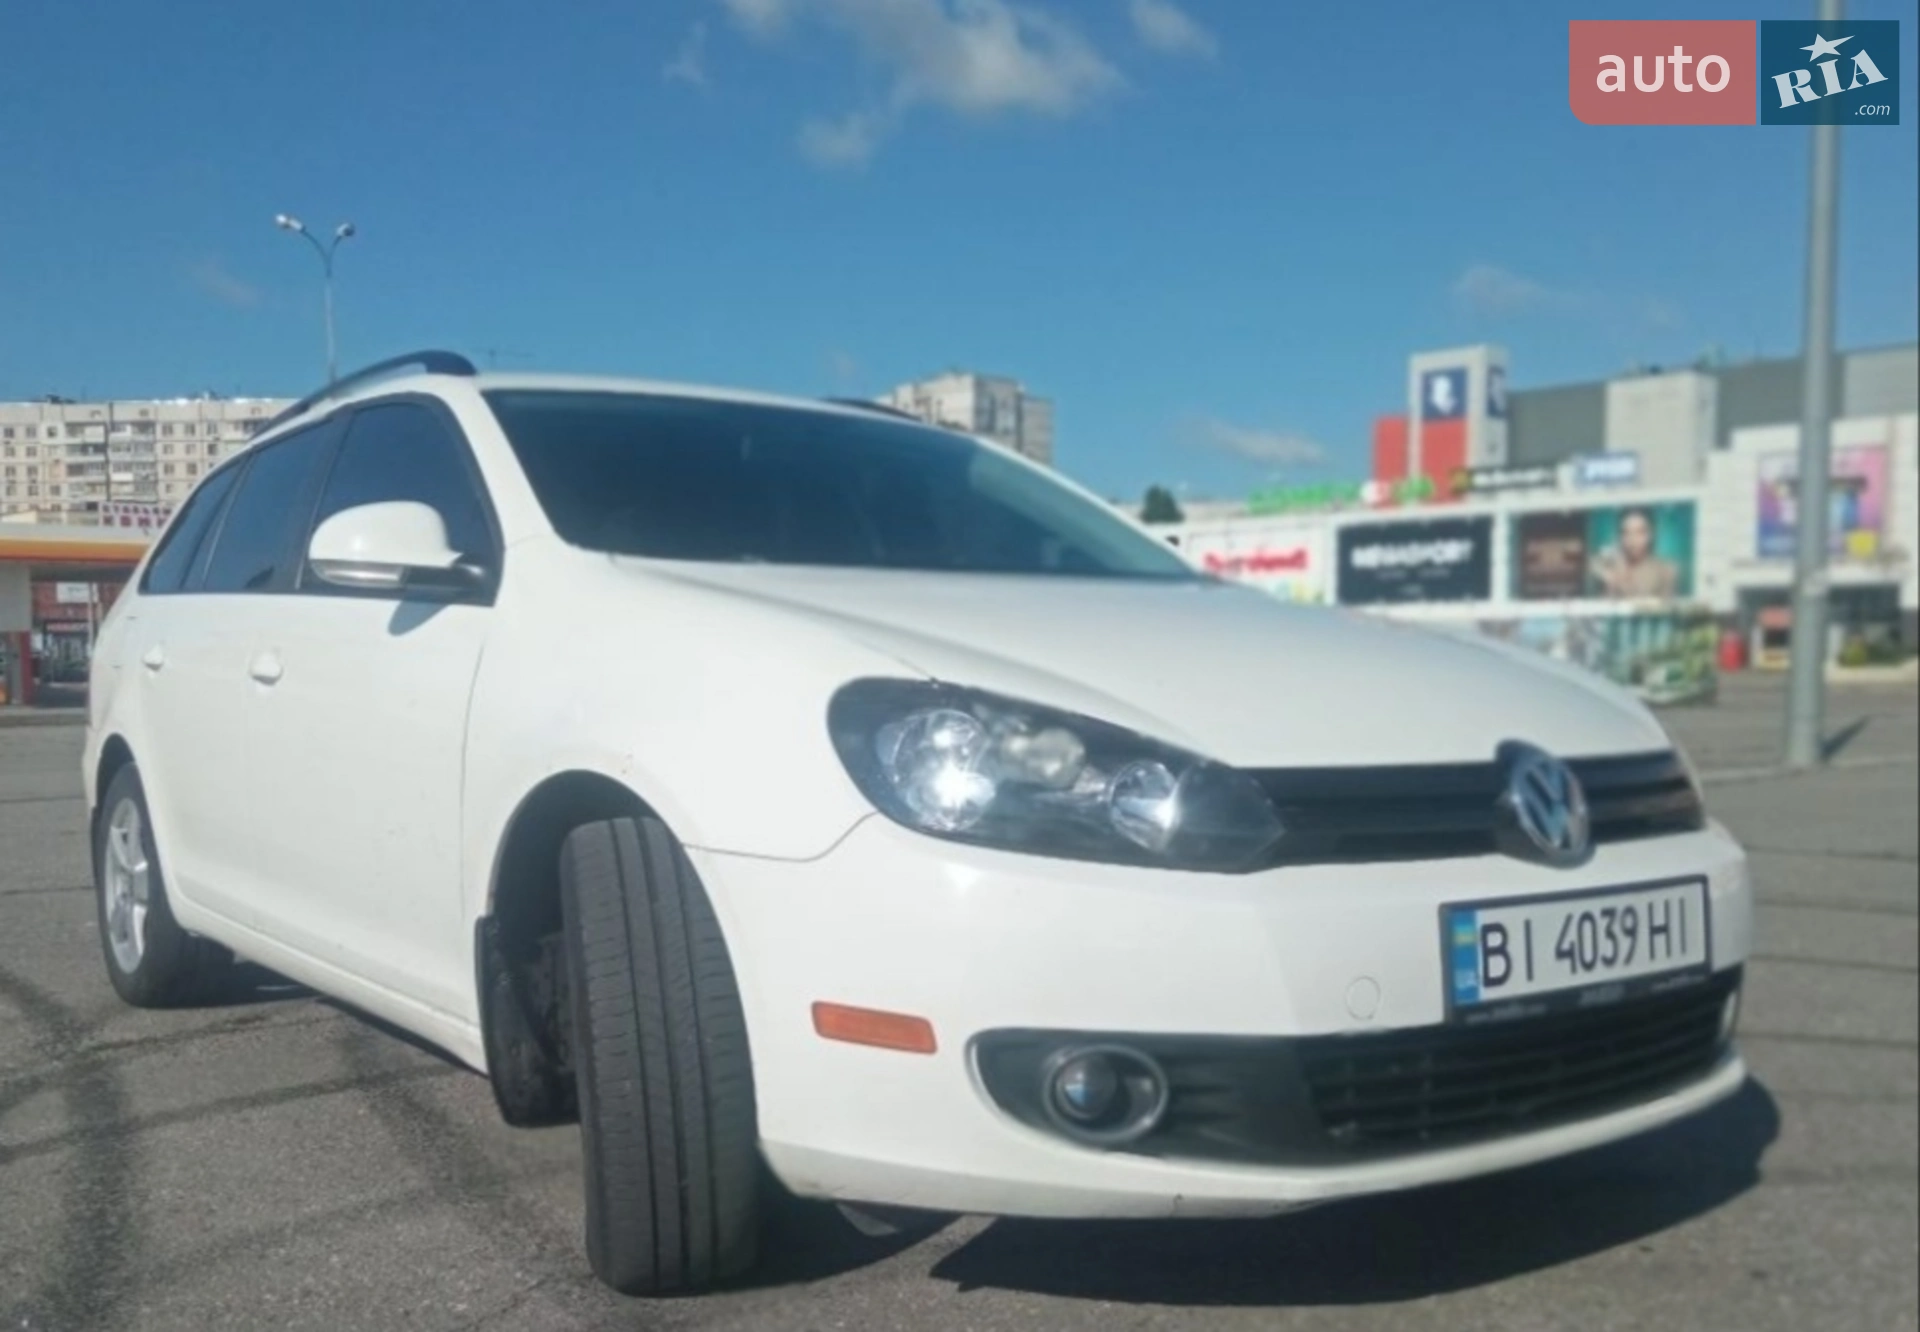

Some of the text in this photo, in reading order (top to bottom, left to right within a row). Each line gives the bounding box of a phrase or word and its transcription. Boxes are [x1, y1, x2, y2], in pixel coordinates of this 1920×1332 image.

[1480, 896, 1687, 988] BI 4039 HI
